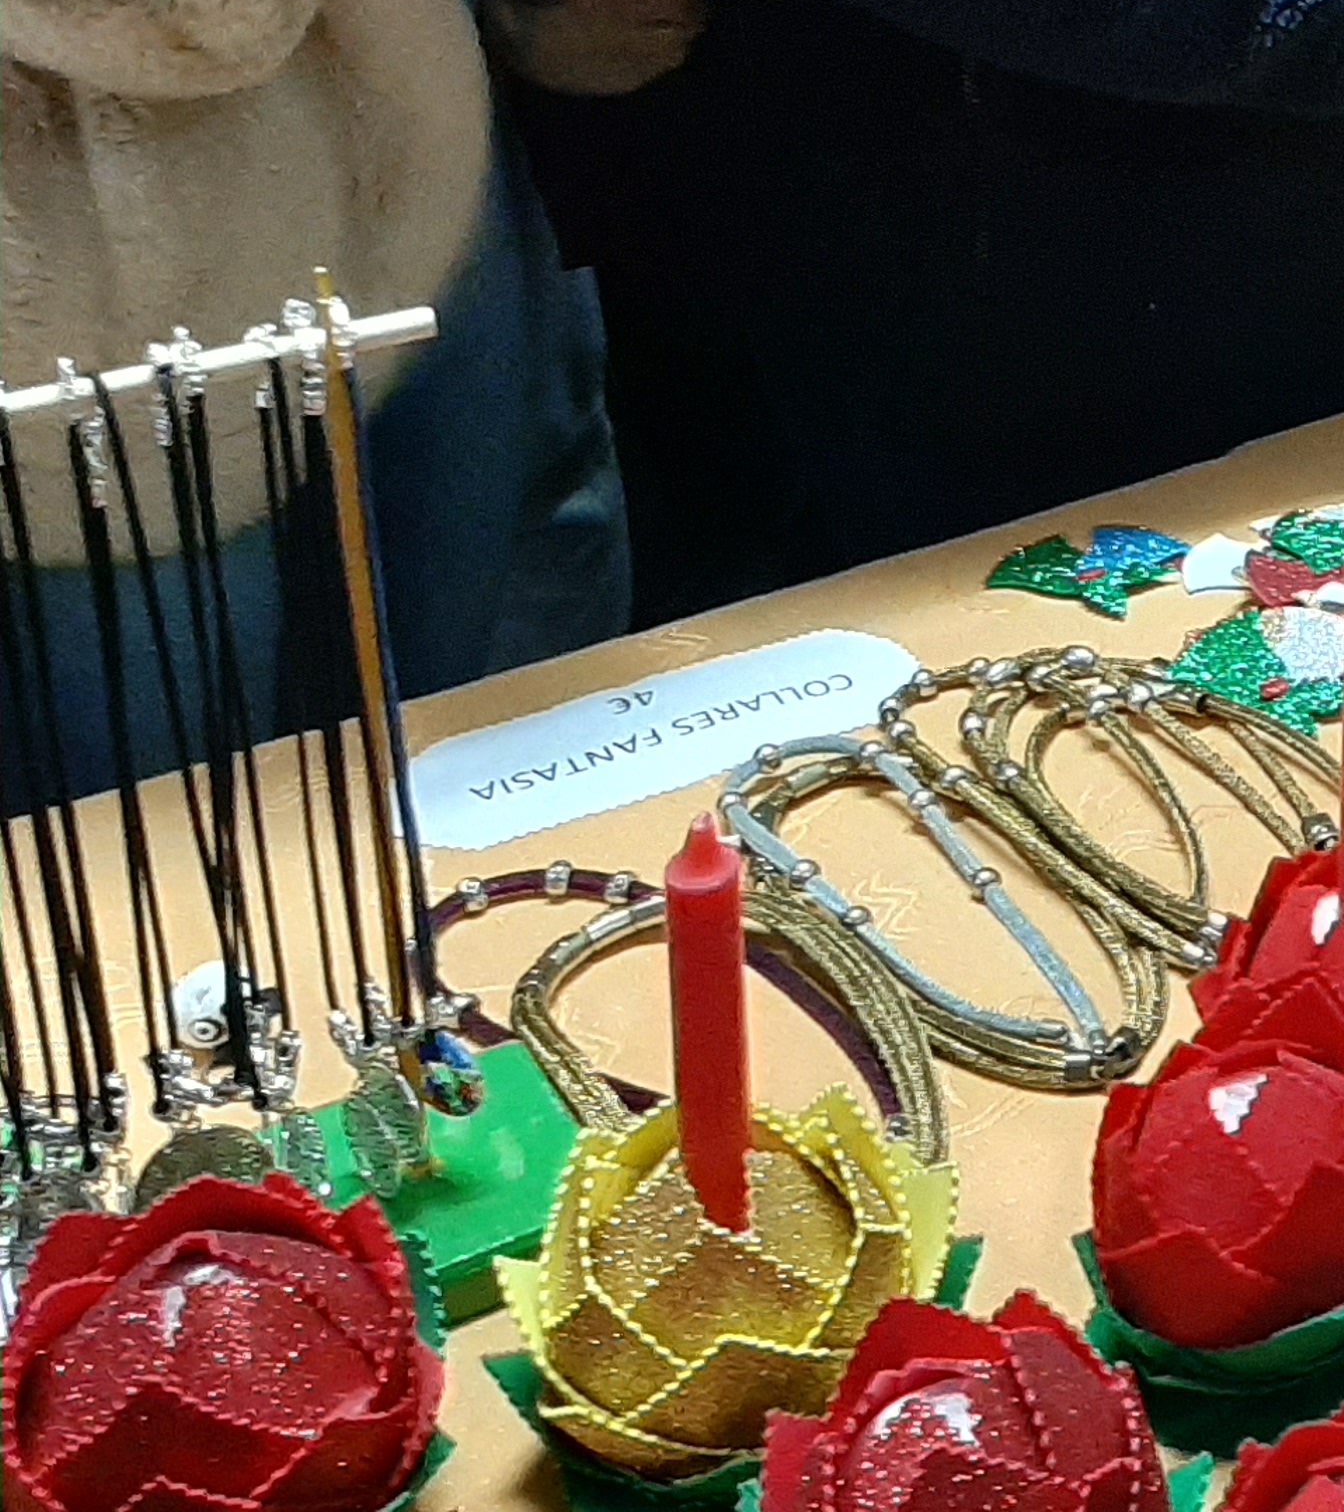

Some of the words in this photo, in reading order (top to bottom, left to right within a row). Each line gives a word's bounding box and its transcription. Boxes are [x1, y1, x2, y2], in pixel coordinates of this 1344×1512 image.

[606, 689, 655, 716] 4€
[671, 673, 853, 737] COLLARES
[468, 727, 664, 801] FANTASIA
